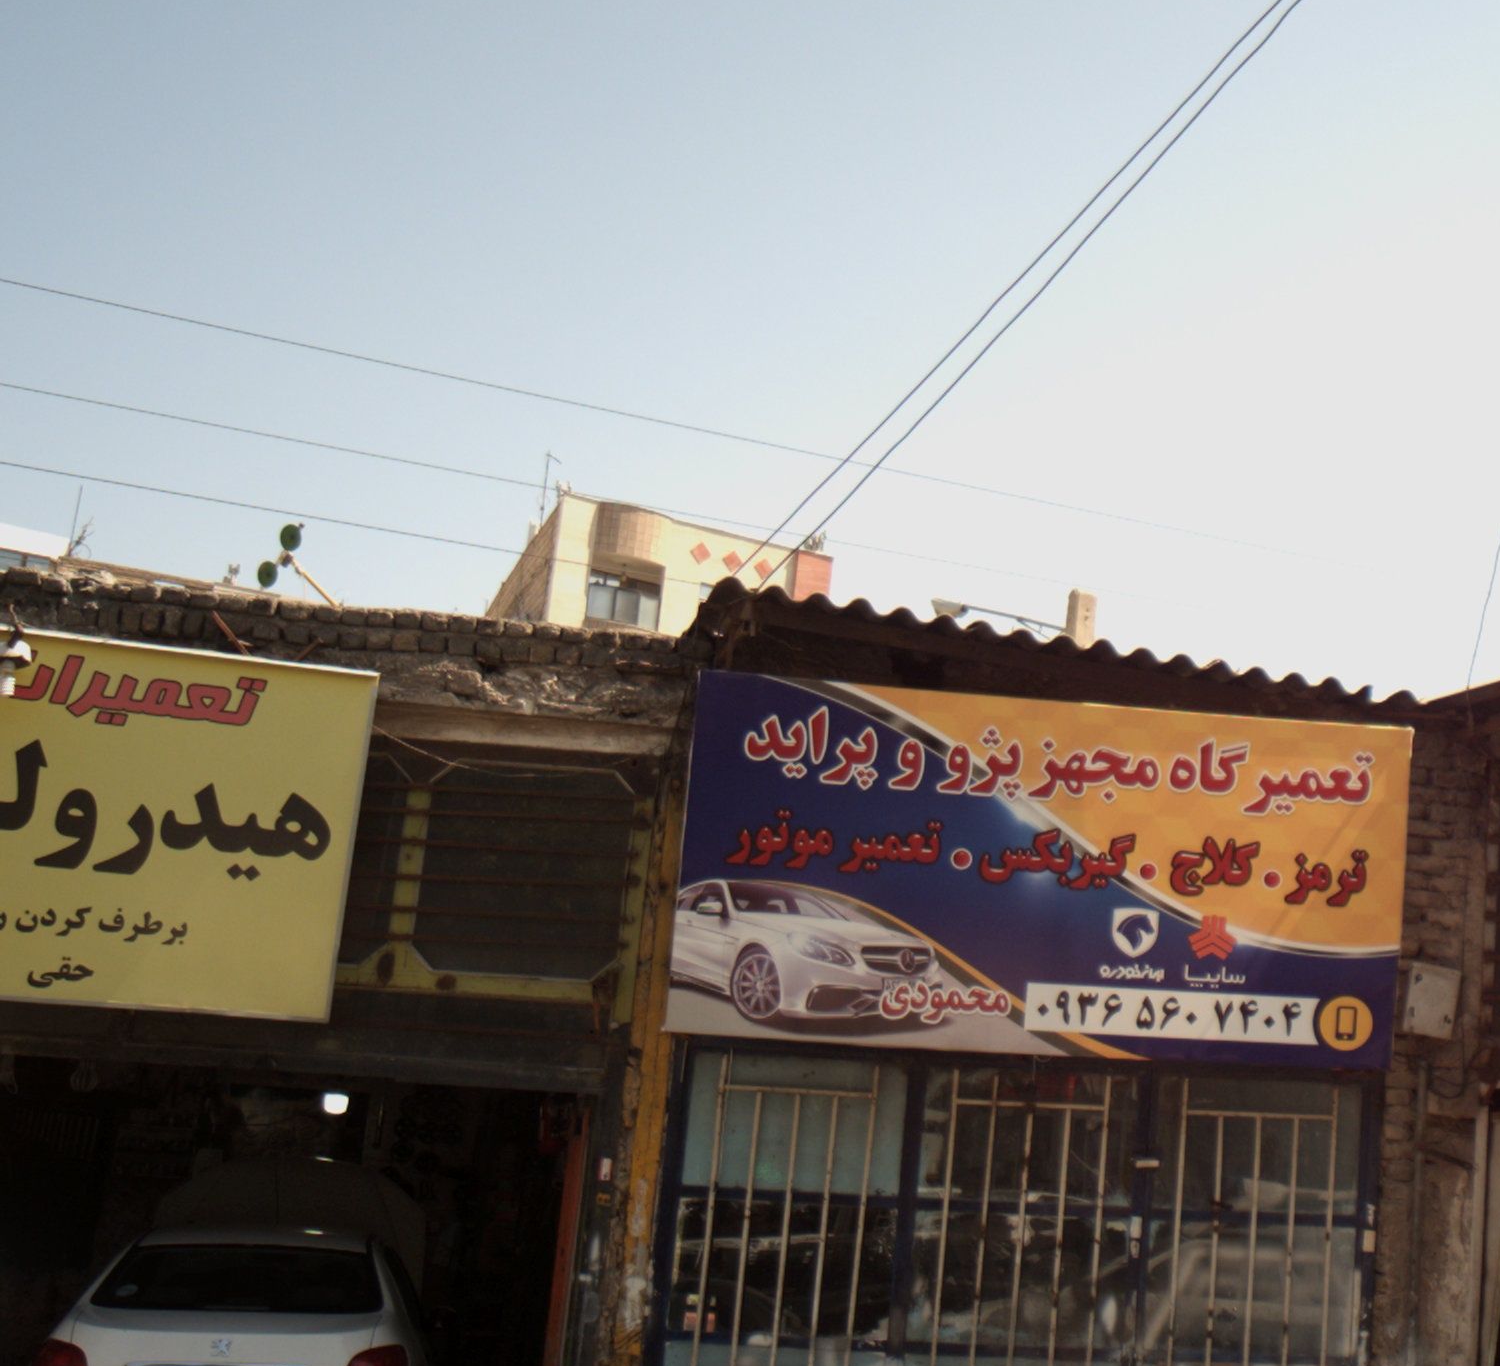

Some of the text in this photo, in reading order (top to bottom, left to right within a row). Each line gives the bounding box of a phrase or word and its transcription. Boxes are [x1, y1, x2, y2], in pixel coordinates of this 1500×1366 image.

[744, 706, 879, 790] پراید
[888, 738, 925, 790] و
[937, 725, 1022, 800] پژو
[1025, 738, 1160, 804] مجهز
[0, 738, 331, 881] هیدرول
[725, 808, 835, 870] موتور
[839, 820, 944, 874] تعمیر
[979, 829, 1136, 891] گیربکس
[1284, 848, 1370, 907] ترمز
[15, 906, 93, 937] کردن
[27, 956, 95, 988] حقی
[1183, 964, 1246, 988] سایپا
[879, 979, 1012, 1024] محمودی
[1037, 989, 1302, 1036] ۰۹۳۶ ۵۶۰ ۷۴۰۴
